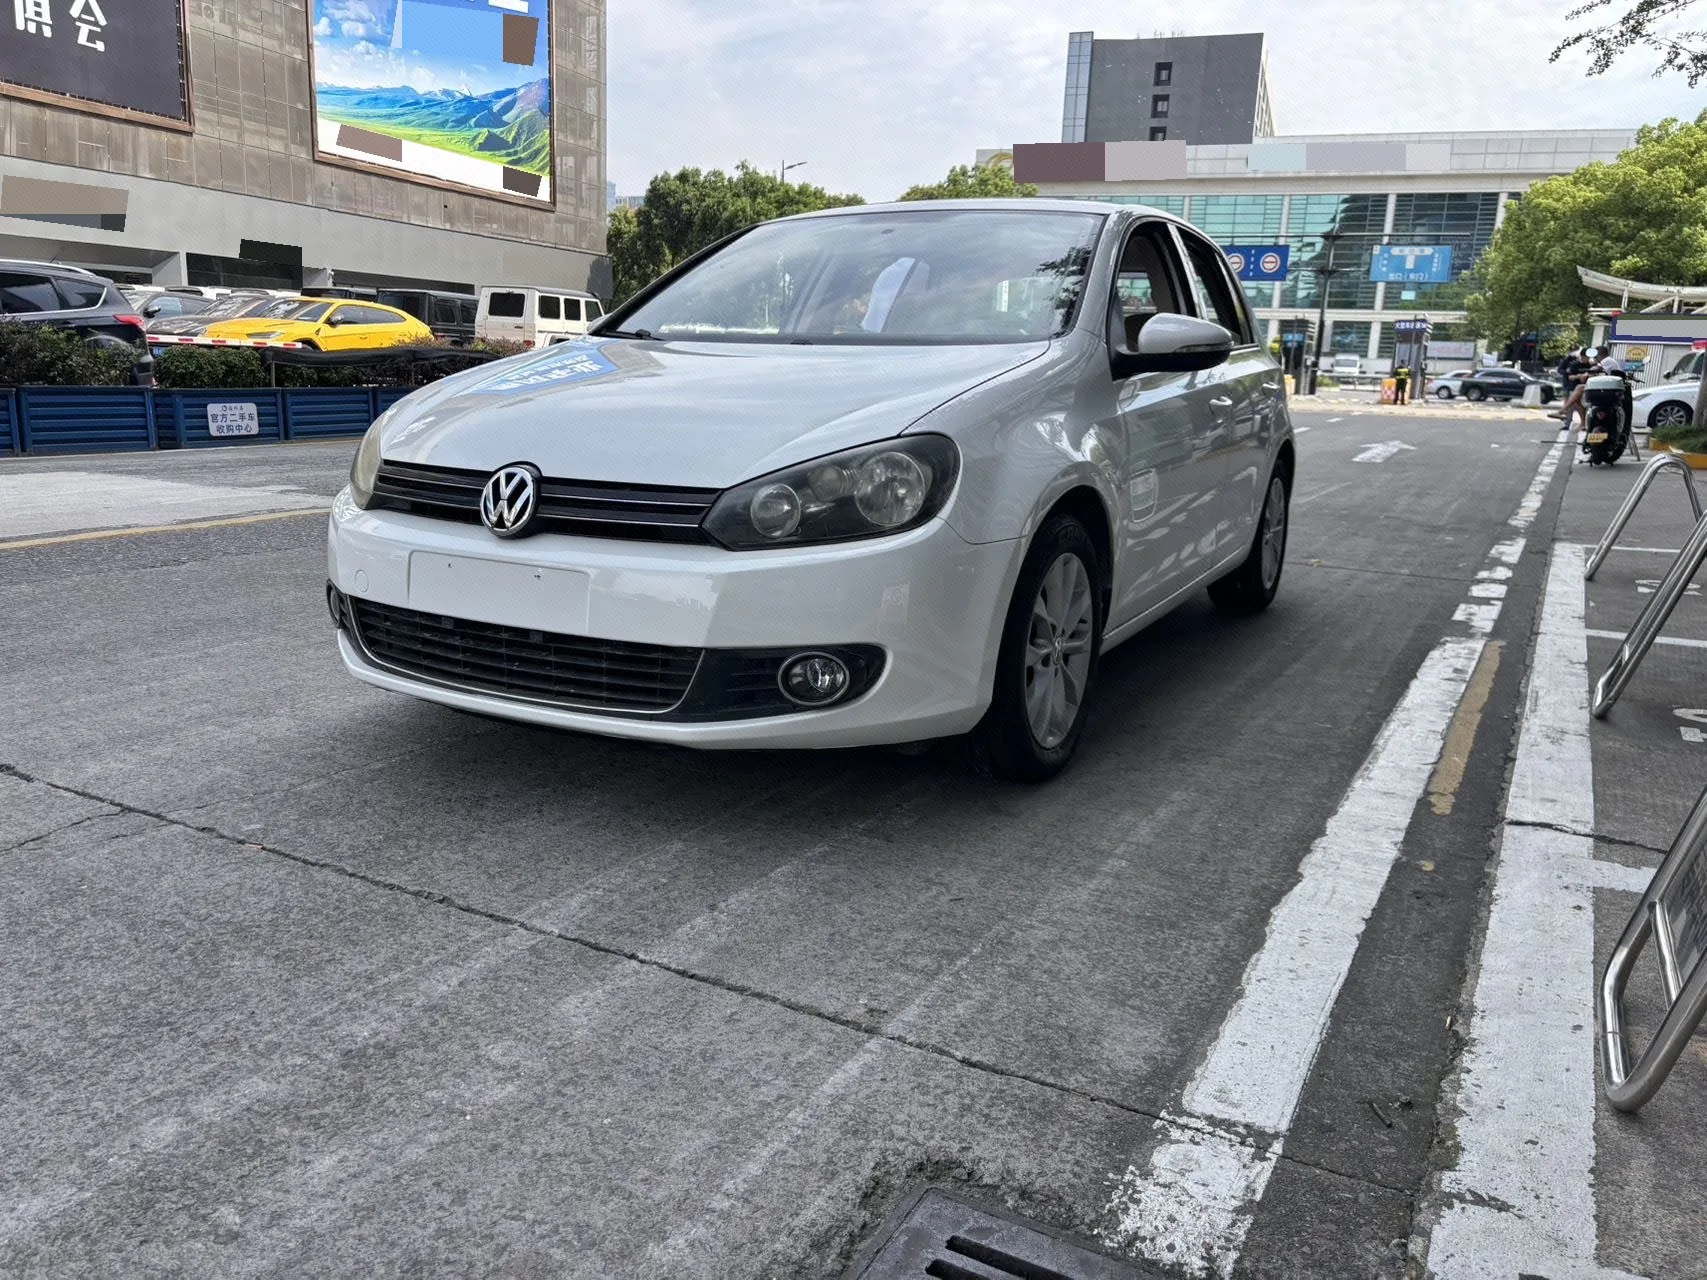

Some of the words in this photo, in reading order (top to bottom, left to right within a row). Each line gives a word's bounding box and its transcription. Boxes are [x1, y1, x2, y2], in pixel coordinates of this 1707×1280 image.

[210, 412, 255, 423] 官方二手车
[216, 423, 253, 434] 收购中心
